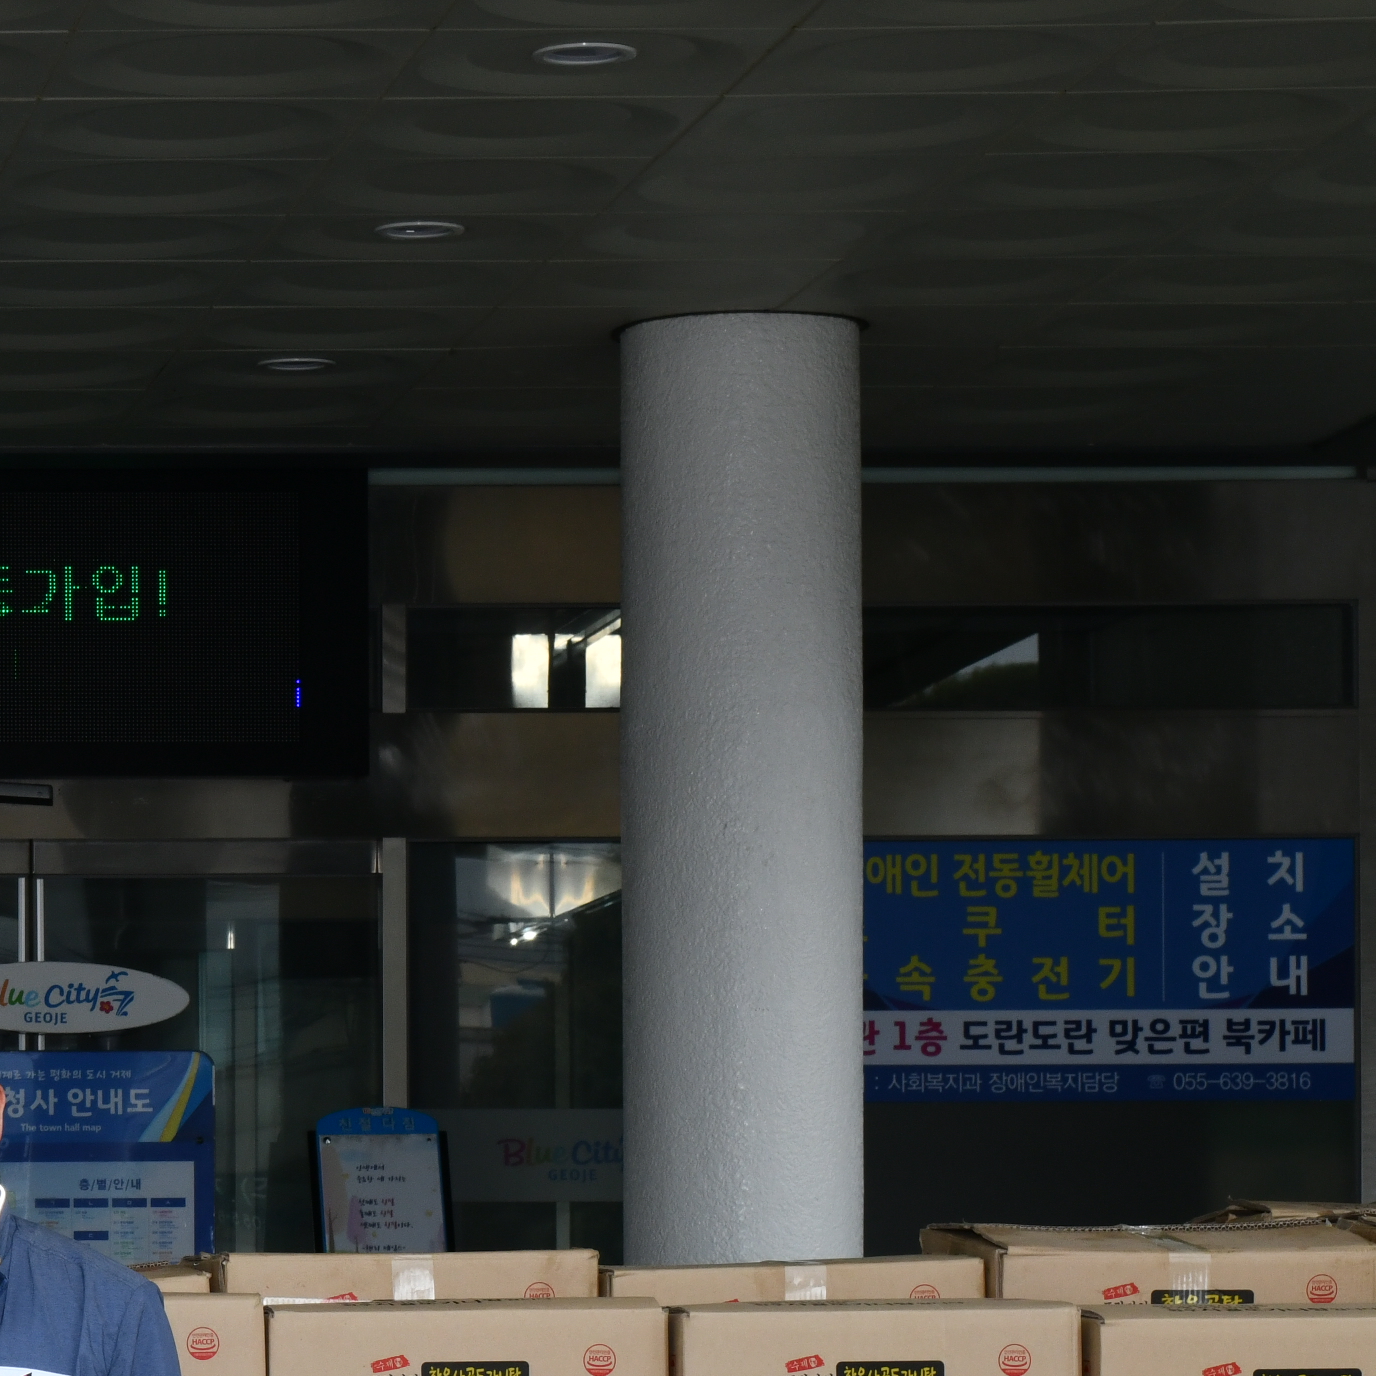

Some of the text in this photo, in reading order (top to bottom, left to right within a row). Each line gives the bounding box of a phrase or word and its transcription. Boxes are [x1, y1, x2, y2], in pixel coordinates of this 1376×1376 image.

[953, 850, 1136, 899] 전동휠체어
[43, 982, 101, 1014] City
[23, 1011, 68, 1025] GEOJE
[892, 1017, 1327, 1057] 1층 도란도란 맞은편 북카페
[888, 1072, 1311, 1094] 사회복지과 장애인복지담당 055-639-3816
[5, 1088, 154, 1118] 청사 안내도
[21, 1123, 102, 1134] The town hall map
